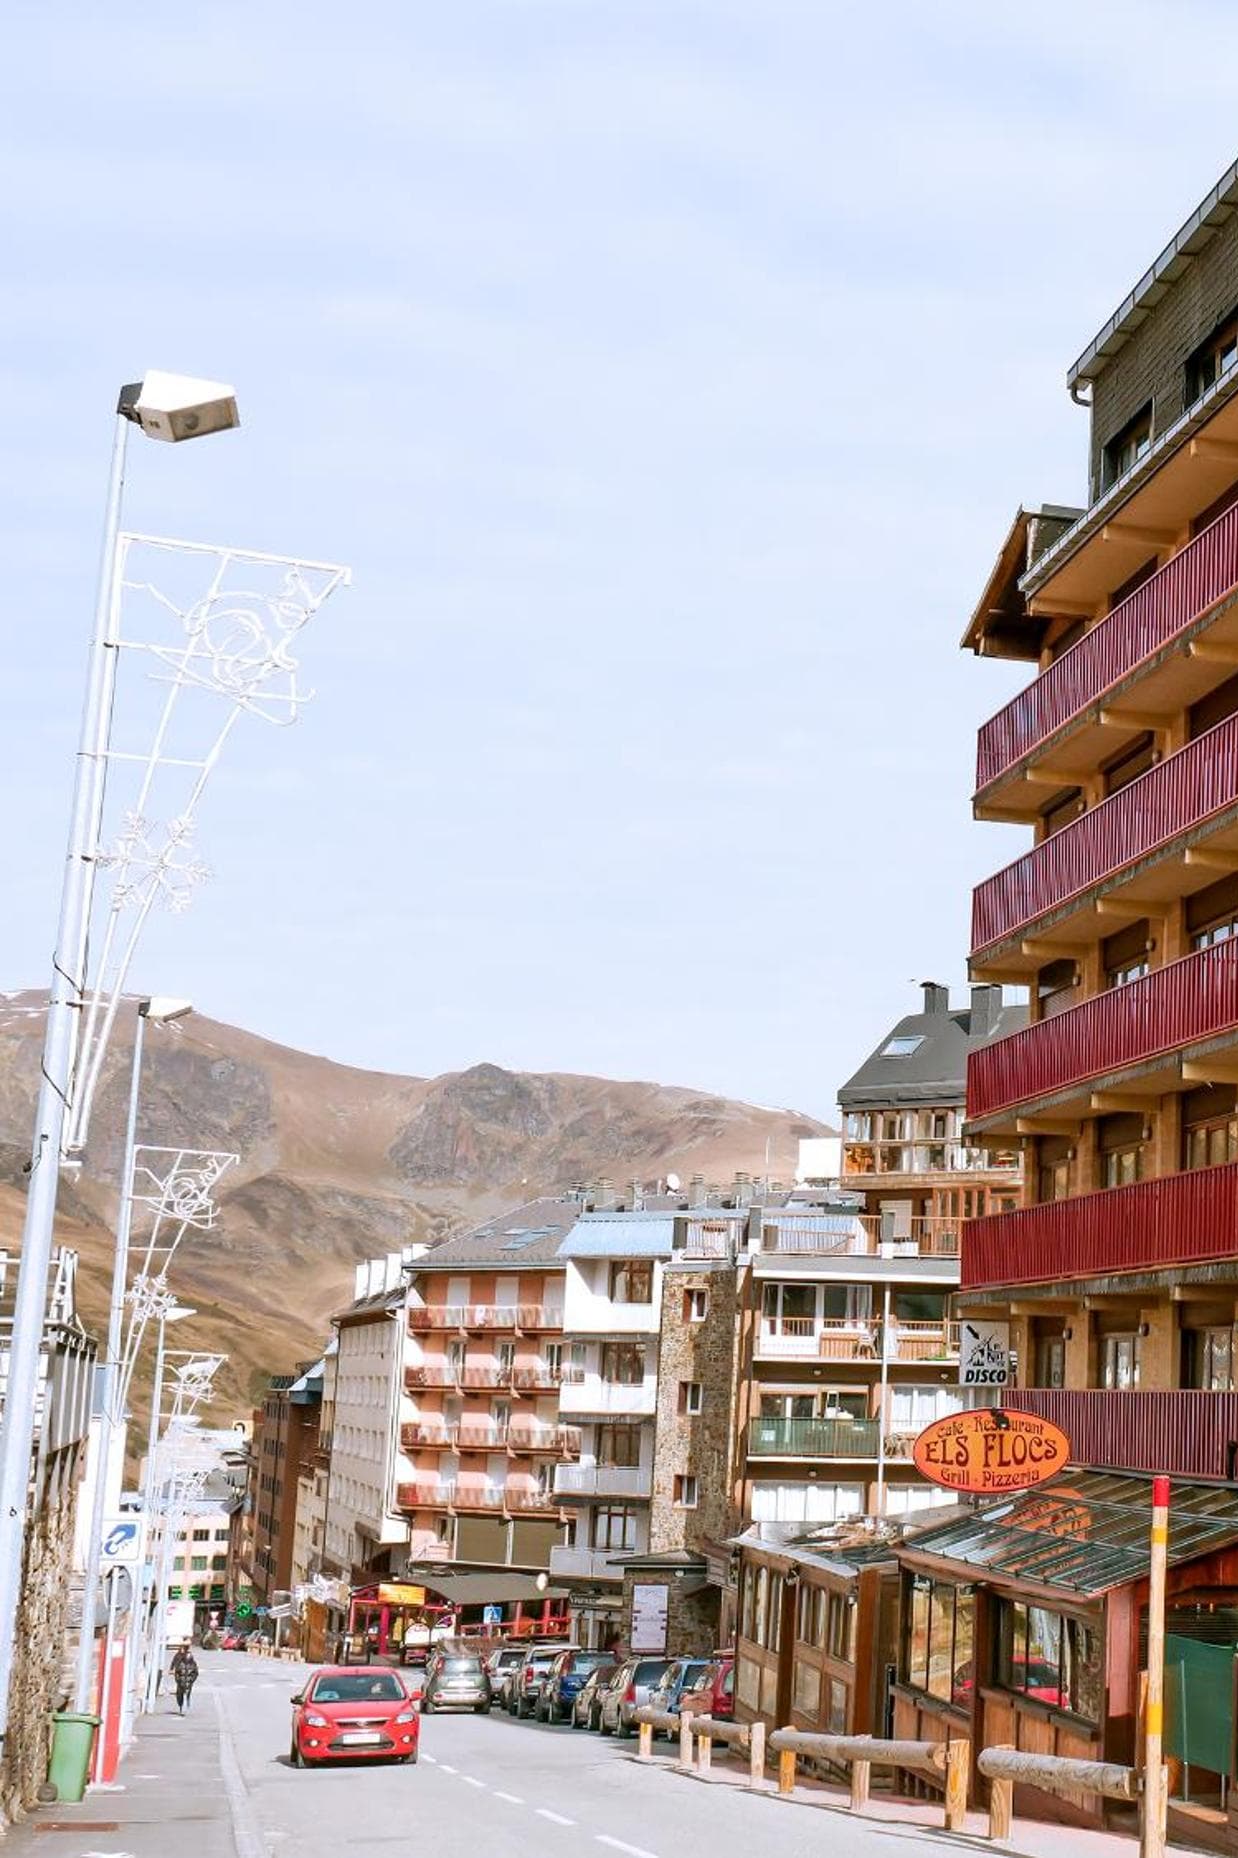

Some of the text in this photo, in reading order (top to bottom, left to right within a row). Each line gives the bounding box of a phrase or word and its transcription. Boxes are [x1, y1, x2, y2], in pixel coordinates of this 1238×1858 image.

[965, 1369, 1006, 1383] DISCO
[973, 1415, 1044, 1434] Resurant
[925, 1433, 1058, 1468] ELS FLOCS
[940, 1467, 1039, 1487] Grill Pizzeria
